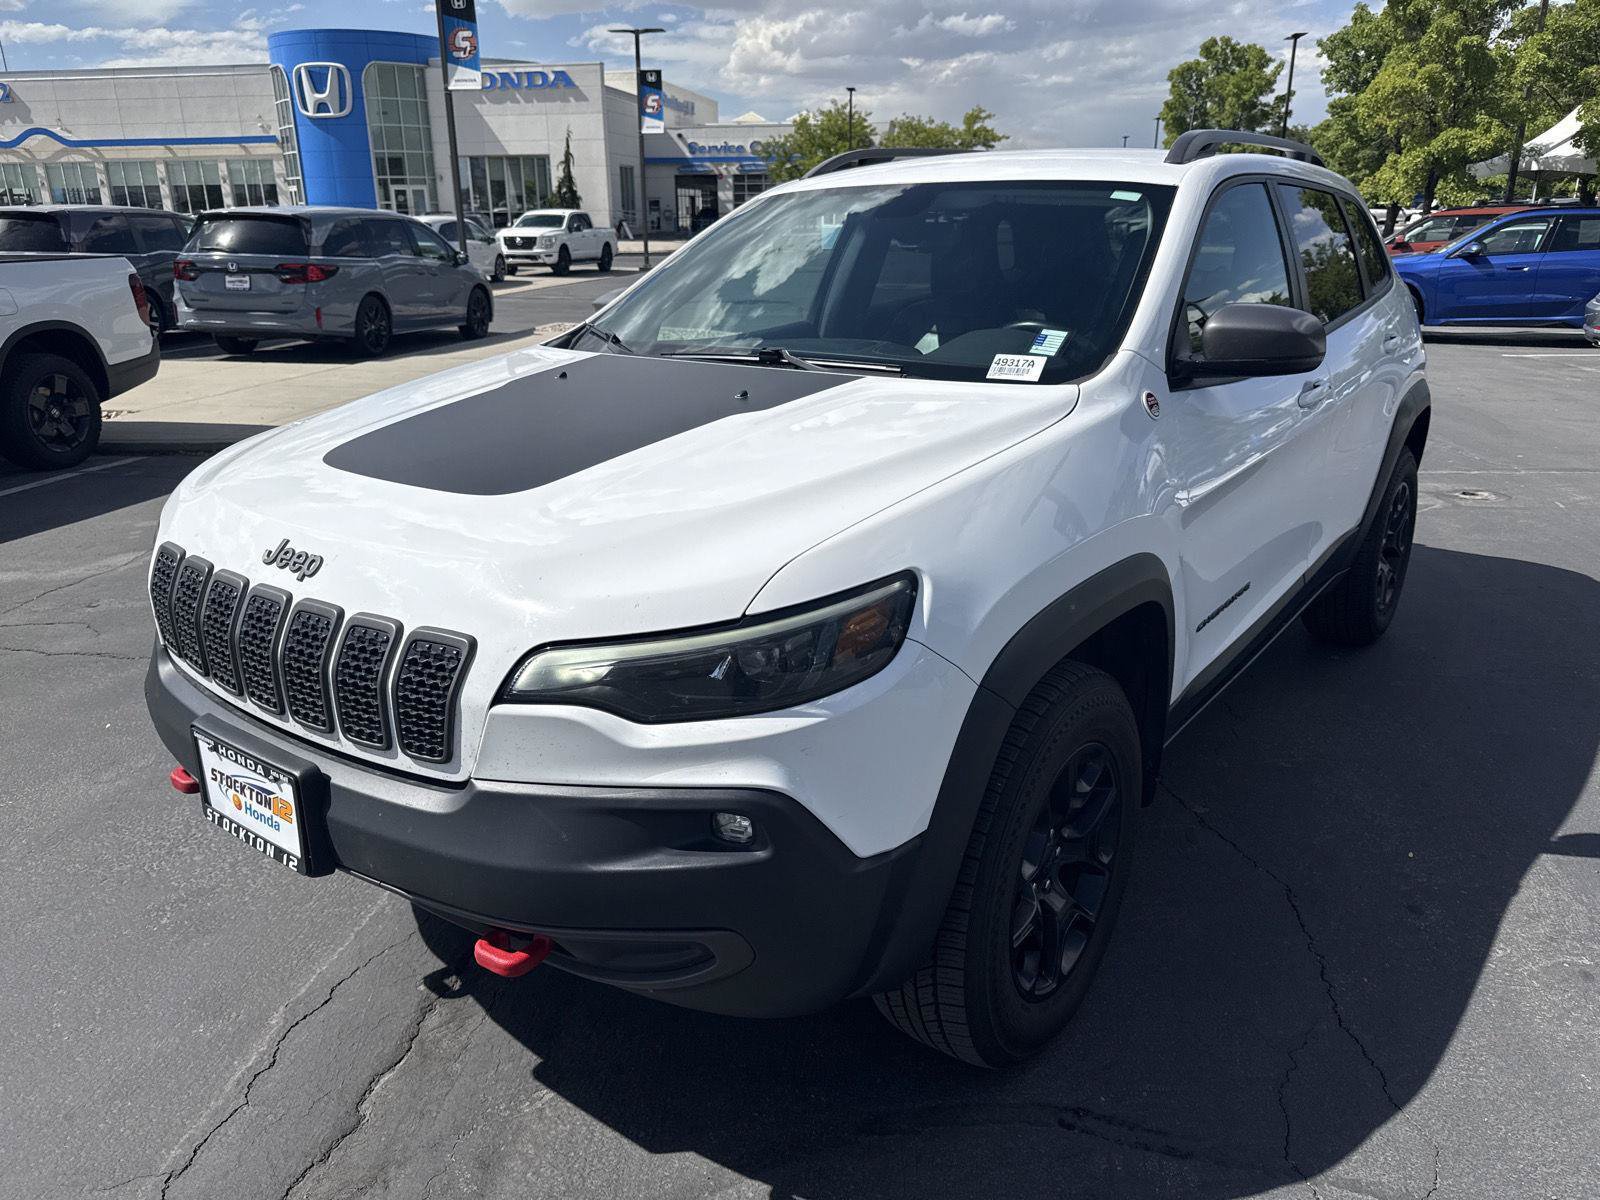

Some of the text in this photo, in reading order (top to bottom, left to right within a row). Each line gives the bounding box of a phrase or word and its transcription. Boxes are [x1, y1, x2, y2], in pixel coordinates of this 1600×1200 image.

[481, 70, 577, 90] ONDA
[688, 141, 745, 155] Service
[994, 358, 1035, 368] 49317A
[262, 538, 324, 582] Jeep
[218, 744, 265, 776] HONDA
[210, 767, 272, 811] STOCKTON
[244, 801, 281, 832] Honda
[206, 808, 298, 872] STOCKTON 12
